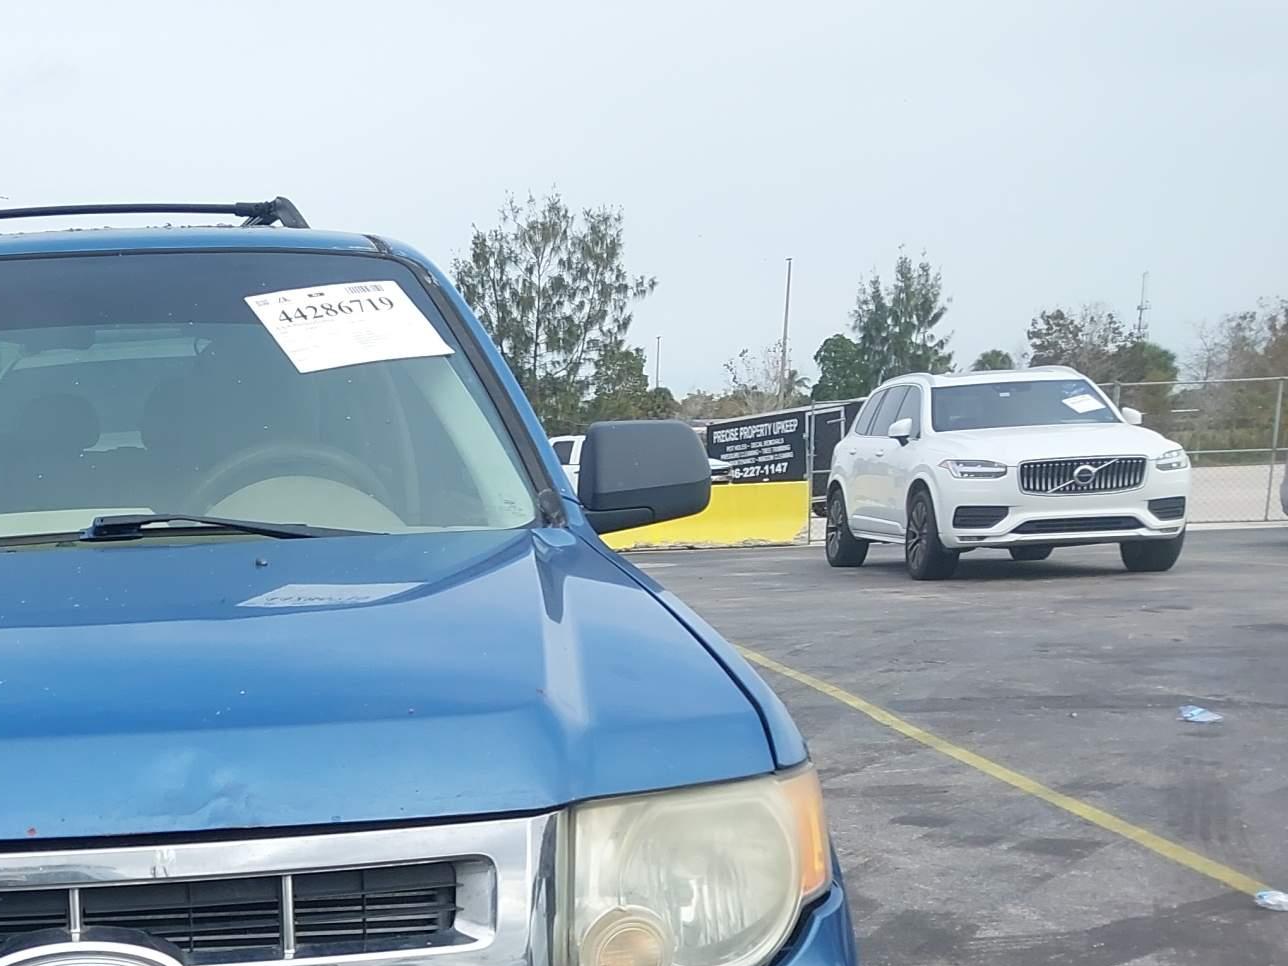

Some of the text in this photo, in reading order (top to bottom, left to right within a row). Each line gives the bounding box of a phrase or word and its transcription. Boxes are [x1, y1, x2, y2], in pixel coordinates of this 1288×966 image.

[278, 296, 395, 324] 44286719
[713, 419, 798, 443] PRECISE PROPERTY UPKEEP
